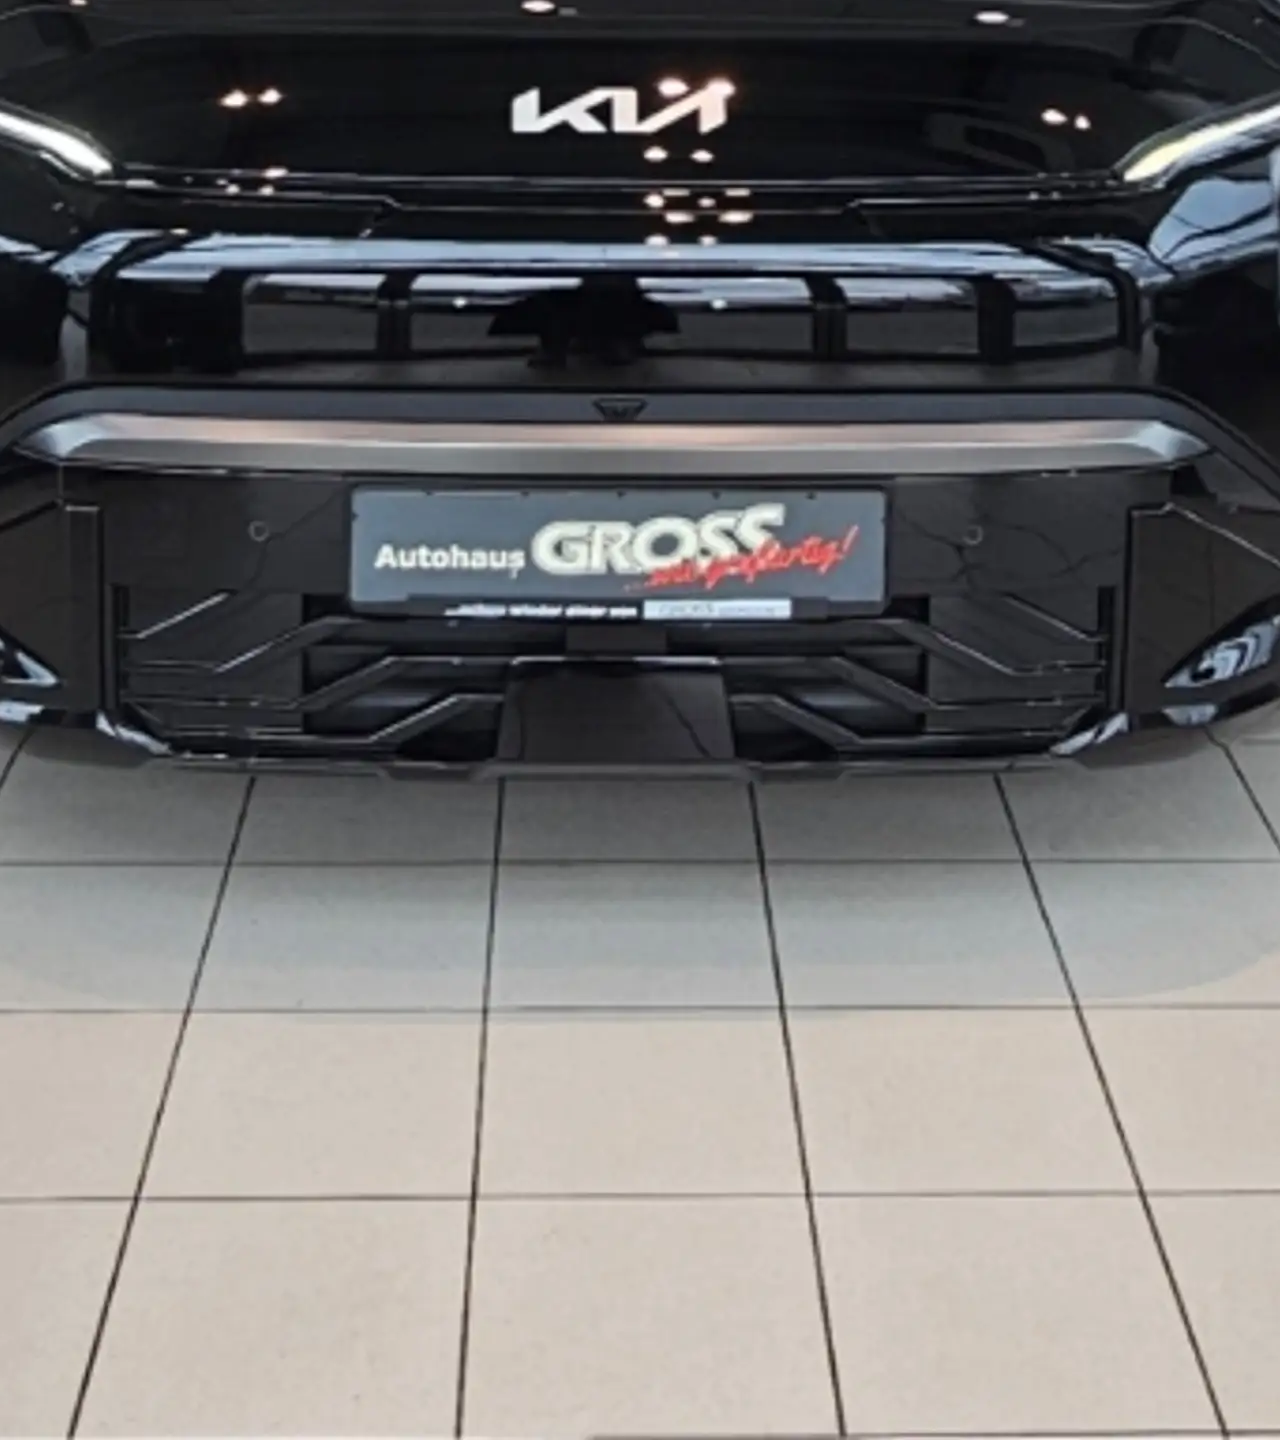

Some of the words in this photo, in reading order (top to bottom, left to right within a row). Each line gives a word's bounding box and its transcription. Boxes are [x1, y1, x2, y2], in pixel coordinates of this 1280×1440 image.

[512, 82, 731, 135] KIA
[374, 543, 526, 570] Autohaus
[531, 503, 786, 575] GROSS
